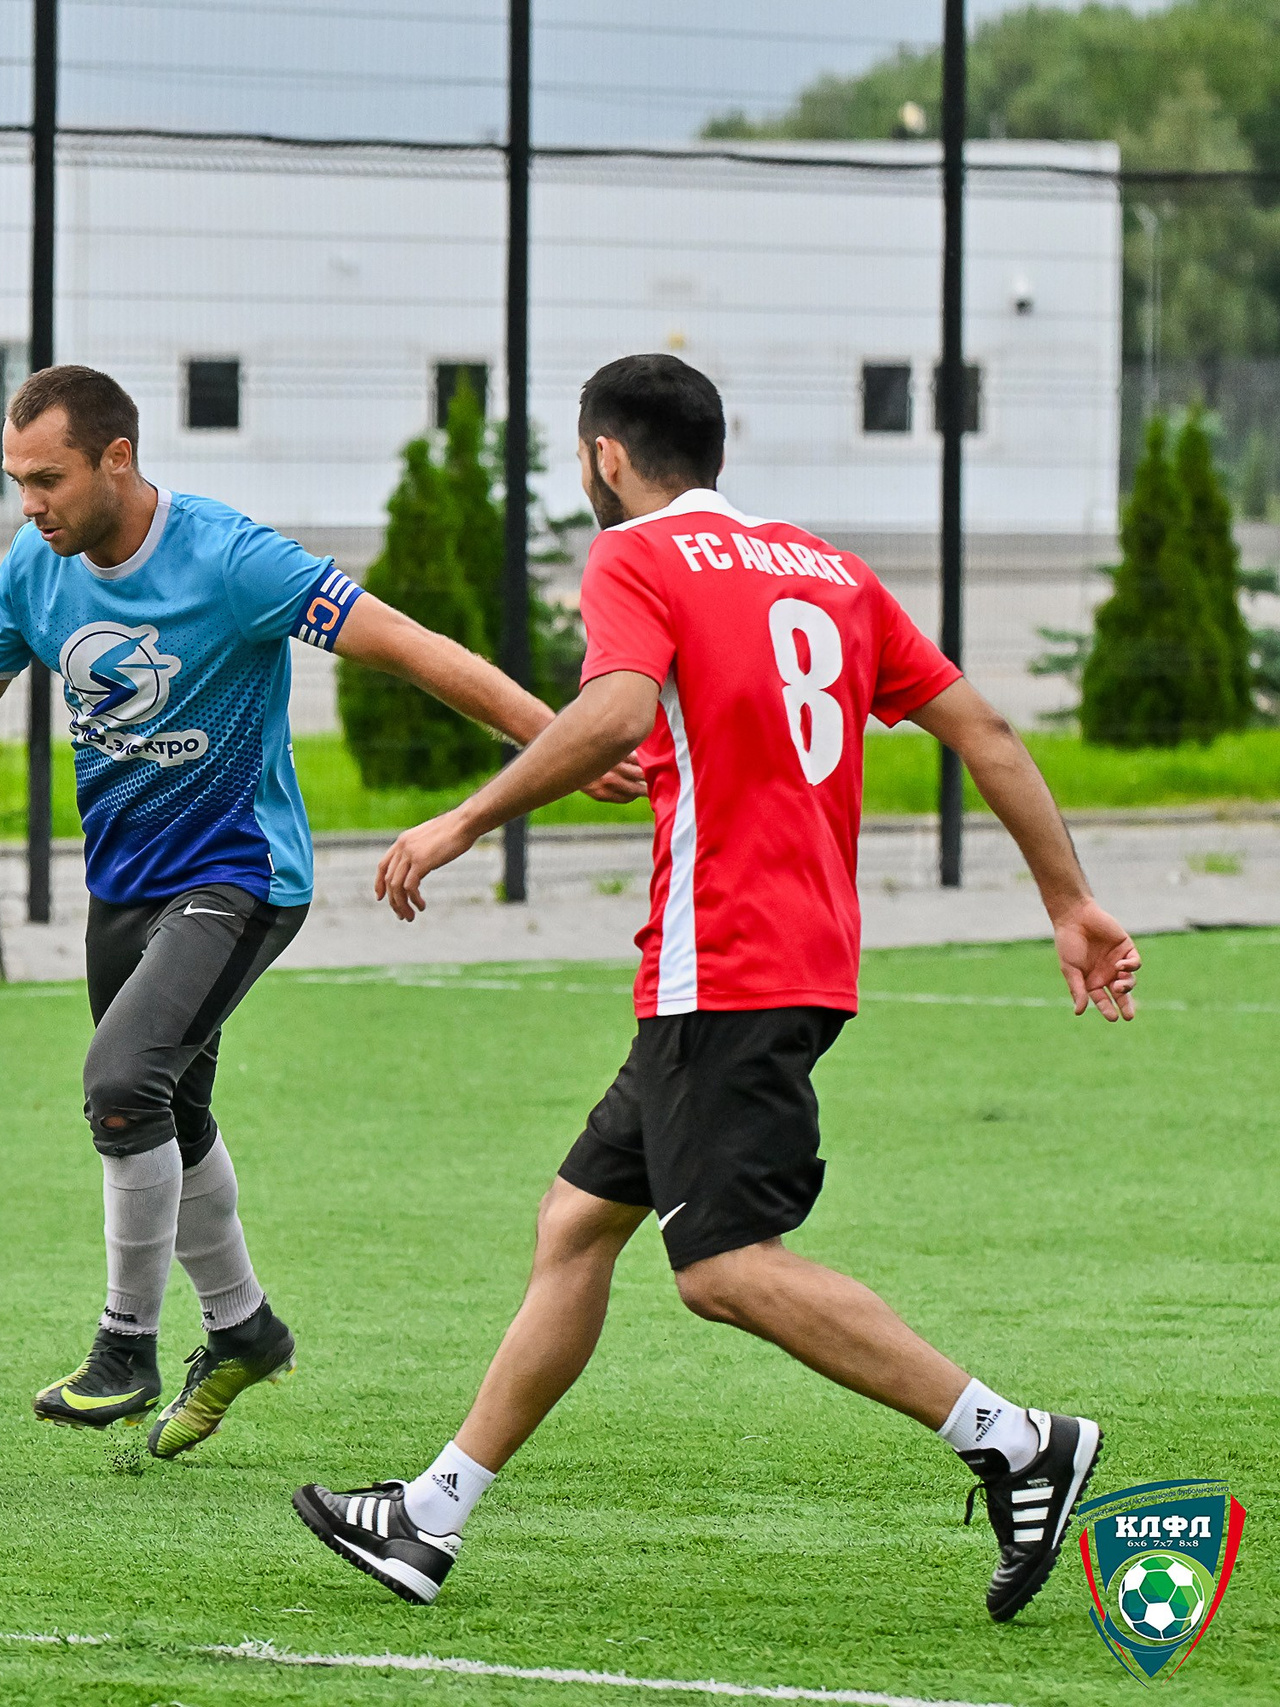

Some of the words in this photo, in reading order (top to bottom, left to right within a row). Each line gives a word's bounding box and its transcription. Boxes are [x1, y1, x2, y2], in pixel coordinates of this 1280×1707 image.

[671, 532, 733, 572] FC
[730, 533, 858, 587] ARARAT
[306, 597, 340, 631] C
[768, 597, 844, 787] 8
[975, 1408, 1002, 1442] adidas
[431, 1473, 460, 1502] adidas
